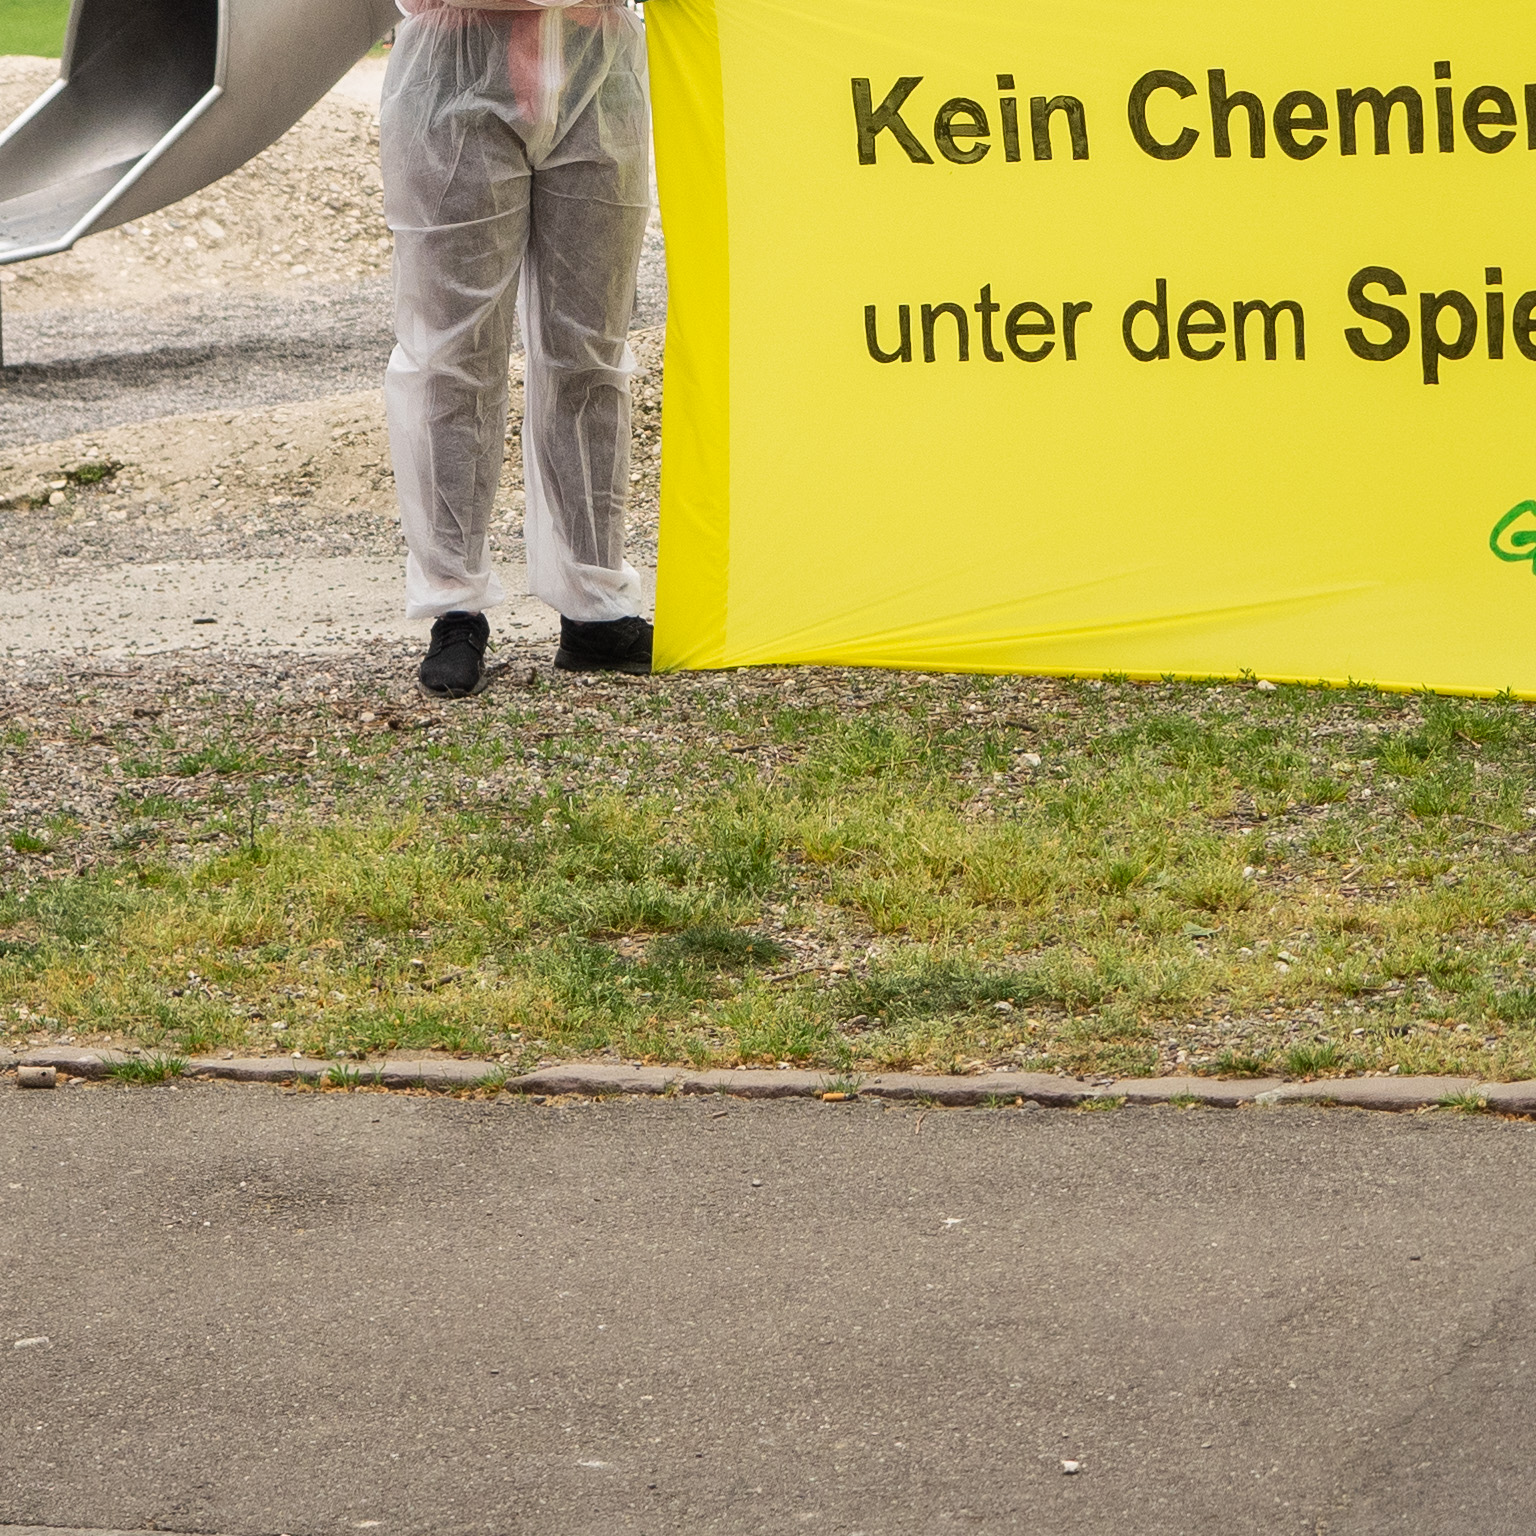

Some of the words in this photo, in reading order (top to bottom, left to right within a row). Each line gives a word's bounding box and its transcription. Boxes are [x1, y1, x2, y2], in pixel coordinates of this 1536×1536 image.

[851, 74, 1090, 166] Kein
[864, 282, 1093, 364] unter
[1122, 278, 1306, 362] dem
